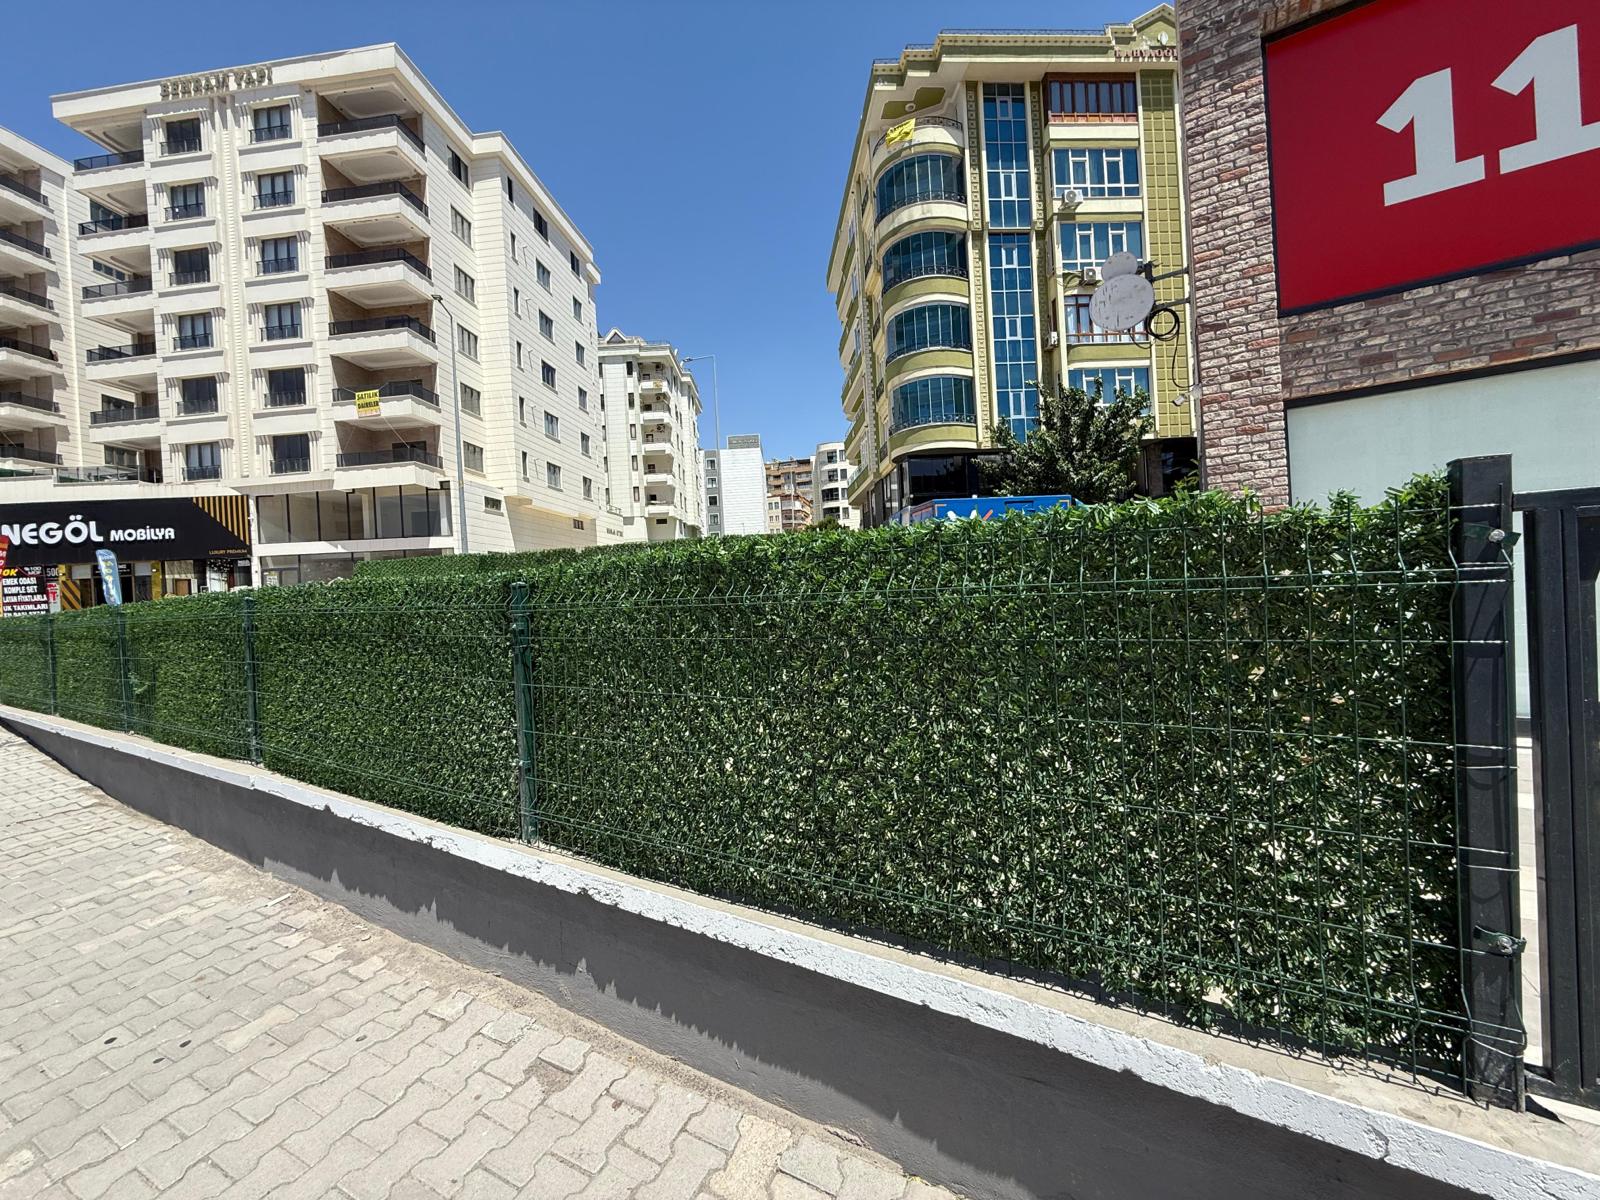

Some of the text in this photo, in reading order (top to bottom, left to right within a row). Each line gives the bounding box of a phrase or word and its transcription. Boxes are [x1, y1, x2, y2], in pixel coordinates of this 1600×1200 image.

[232, 64, 273, 88] YAPI
[1376, 24, 1600, 207] 11
[1, 514, 175, 545] NEGÖL MOBİLYA
[3, 586, 25, 594] KOMPLE
[26, 585, 38, 593] SET
